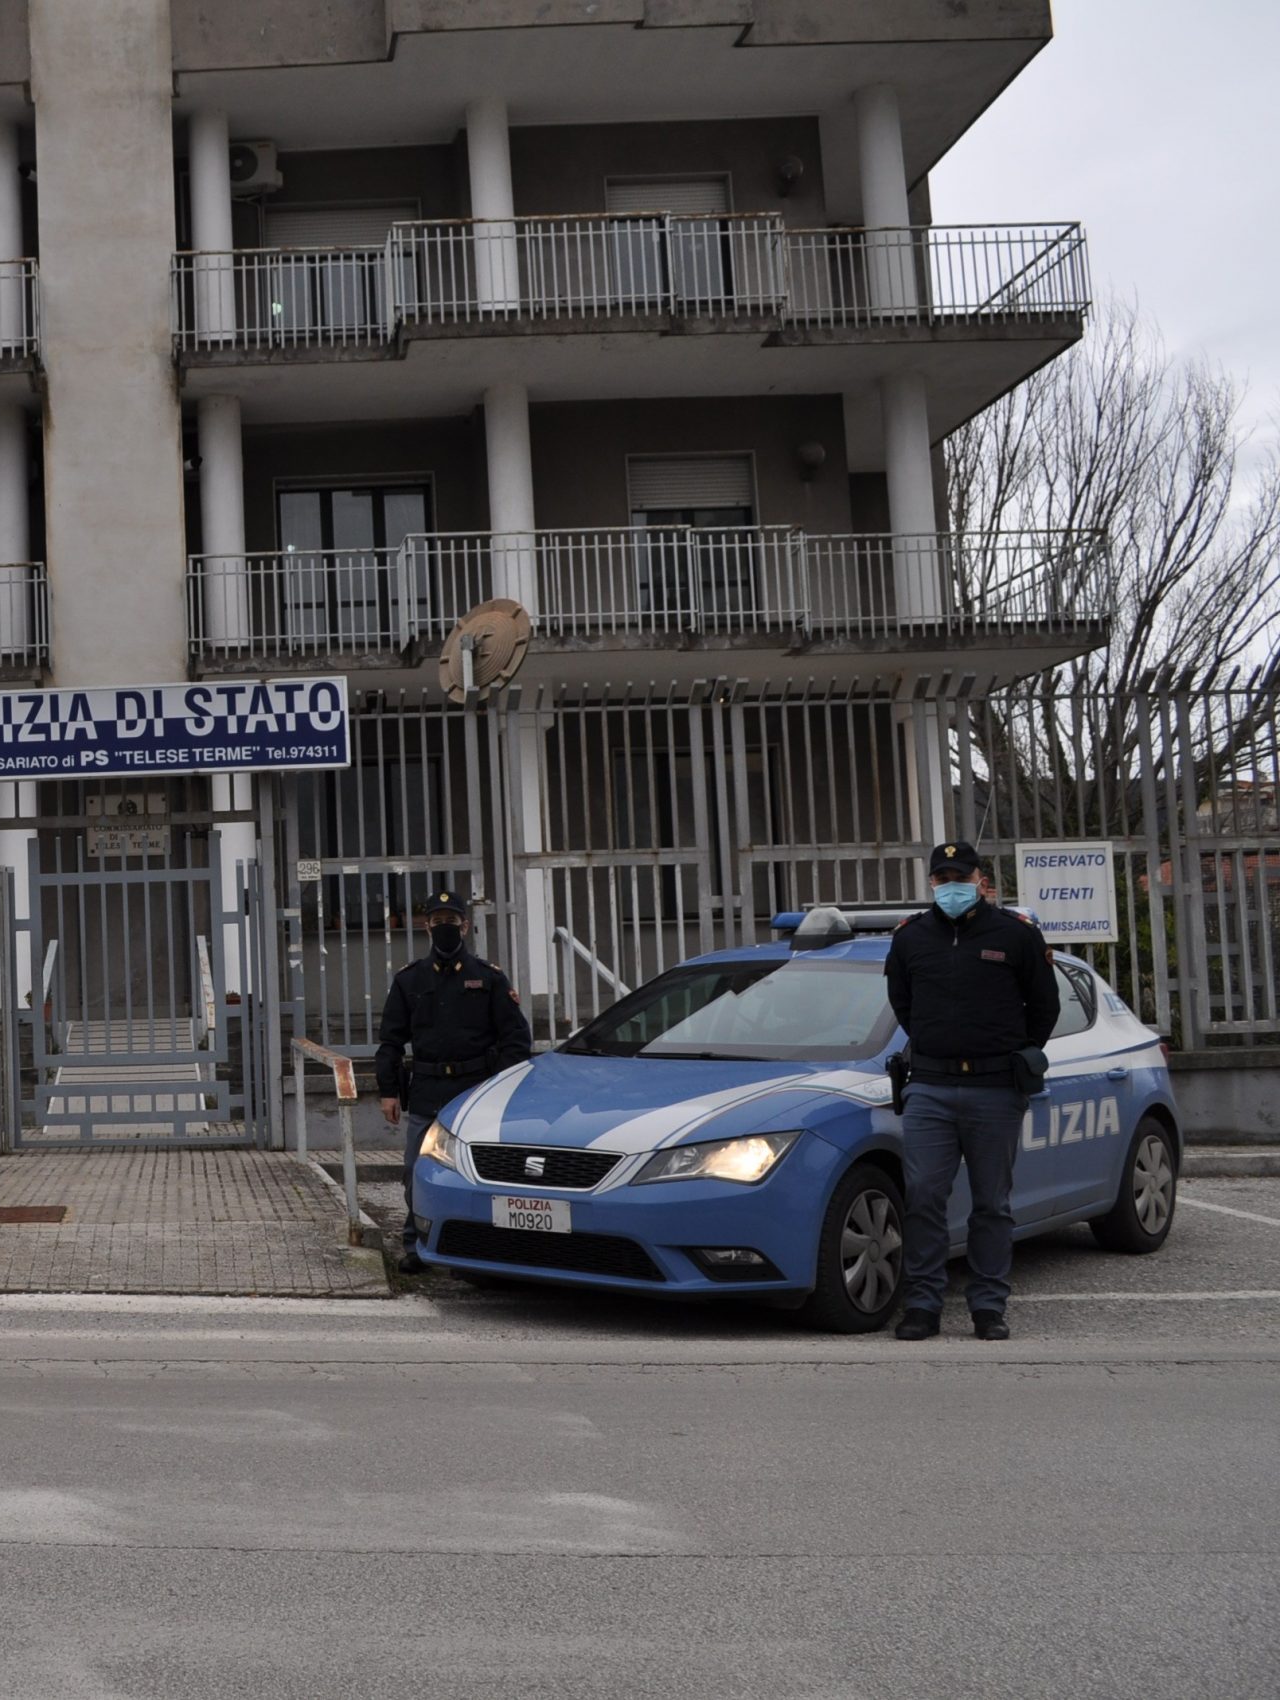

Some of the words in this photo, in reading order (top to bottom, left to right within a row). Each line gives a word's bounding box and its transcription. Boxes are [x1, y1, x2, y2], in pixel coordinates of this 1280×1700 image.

[115, 689, 165, 739] DI
[184, 681, 342, 737] STATO
[62, 754, 75, 768] di
[80, 750, 109, 767] PS
[114, 747, 190, 765] "TELESE
[192, 745, 261, 762] TERME"
[266, 744, 338, 760] Tel.974311
[299, 862, 320, 875] 296
[1024, 854, 1106, 868] RISERVATO
[1039, 887, 1094, 901] UTENTI
[507, 1197, 552, 1212] POLIZIA
[508, 1211, 553, 1231] M0920
